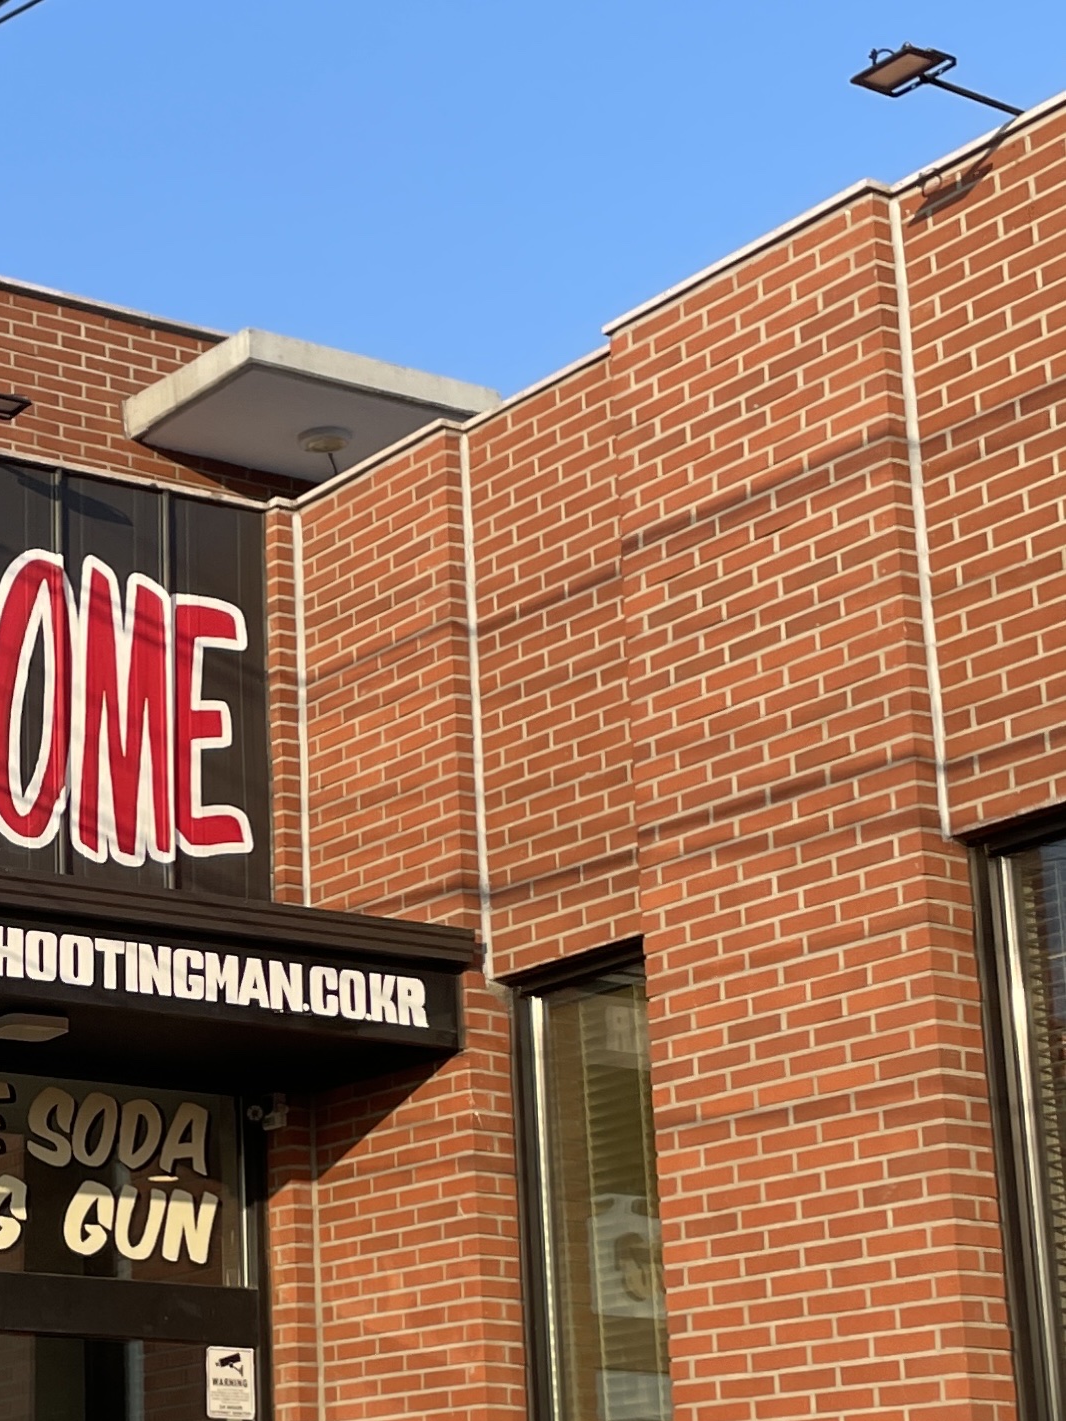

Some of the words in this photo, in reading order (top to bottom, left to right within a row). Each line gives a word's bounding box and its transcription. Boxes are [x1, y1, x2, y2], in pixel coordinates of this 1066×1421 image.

[27, 1086, 209, 1176] SODA
[63, 1180, 219, 1265] GUN
[212, 1378, 248, 1388] WARNING
